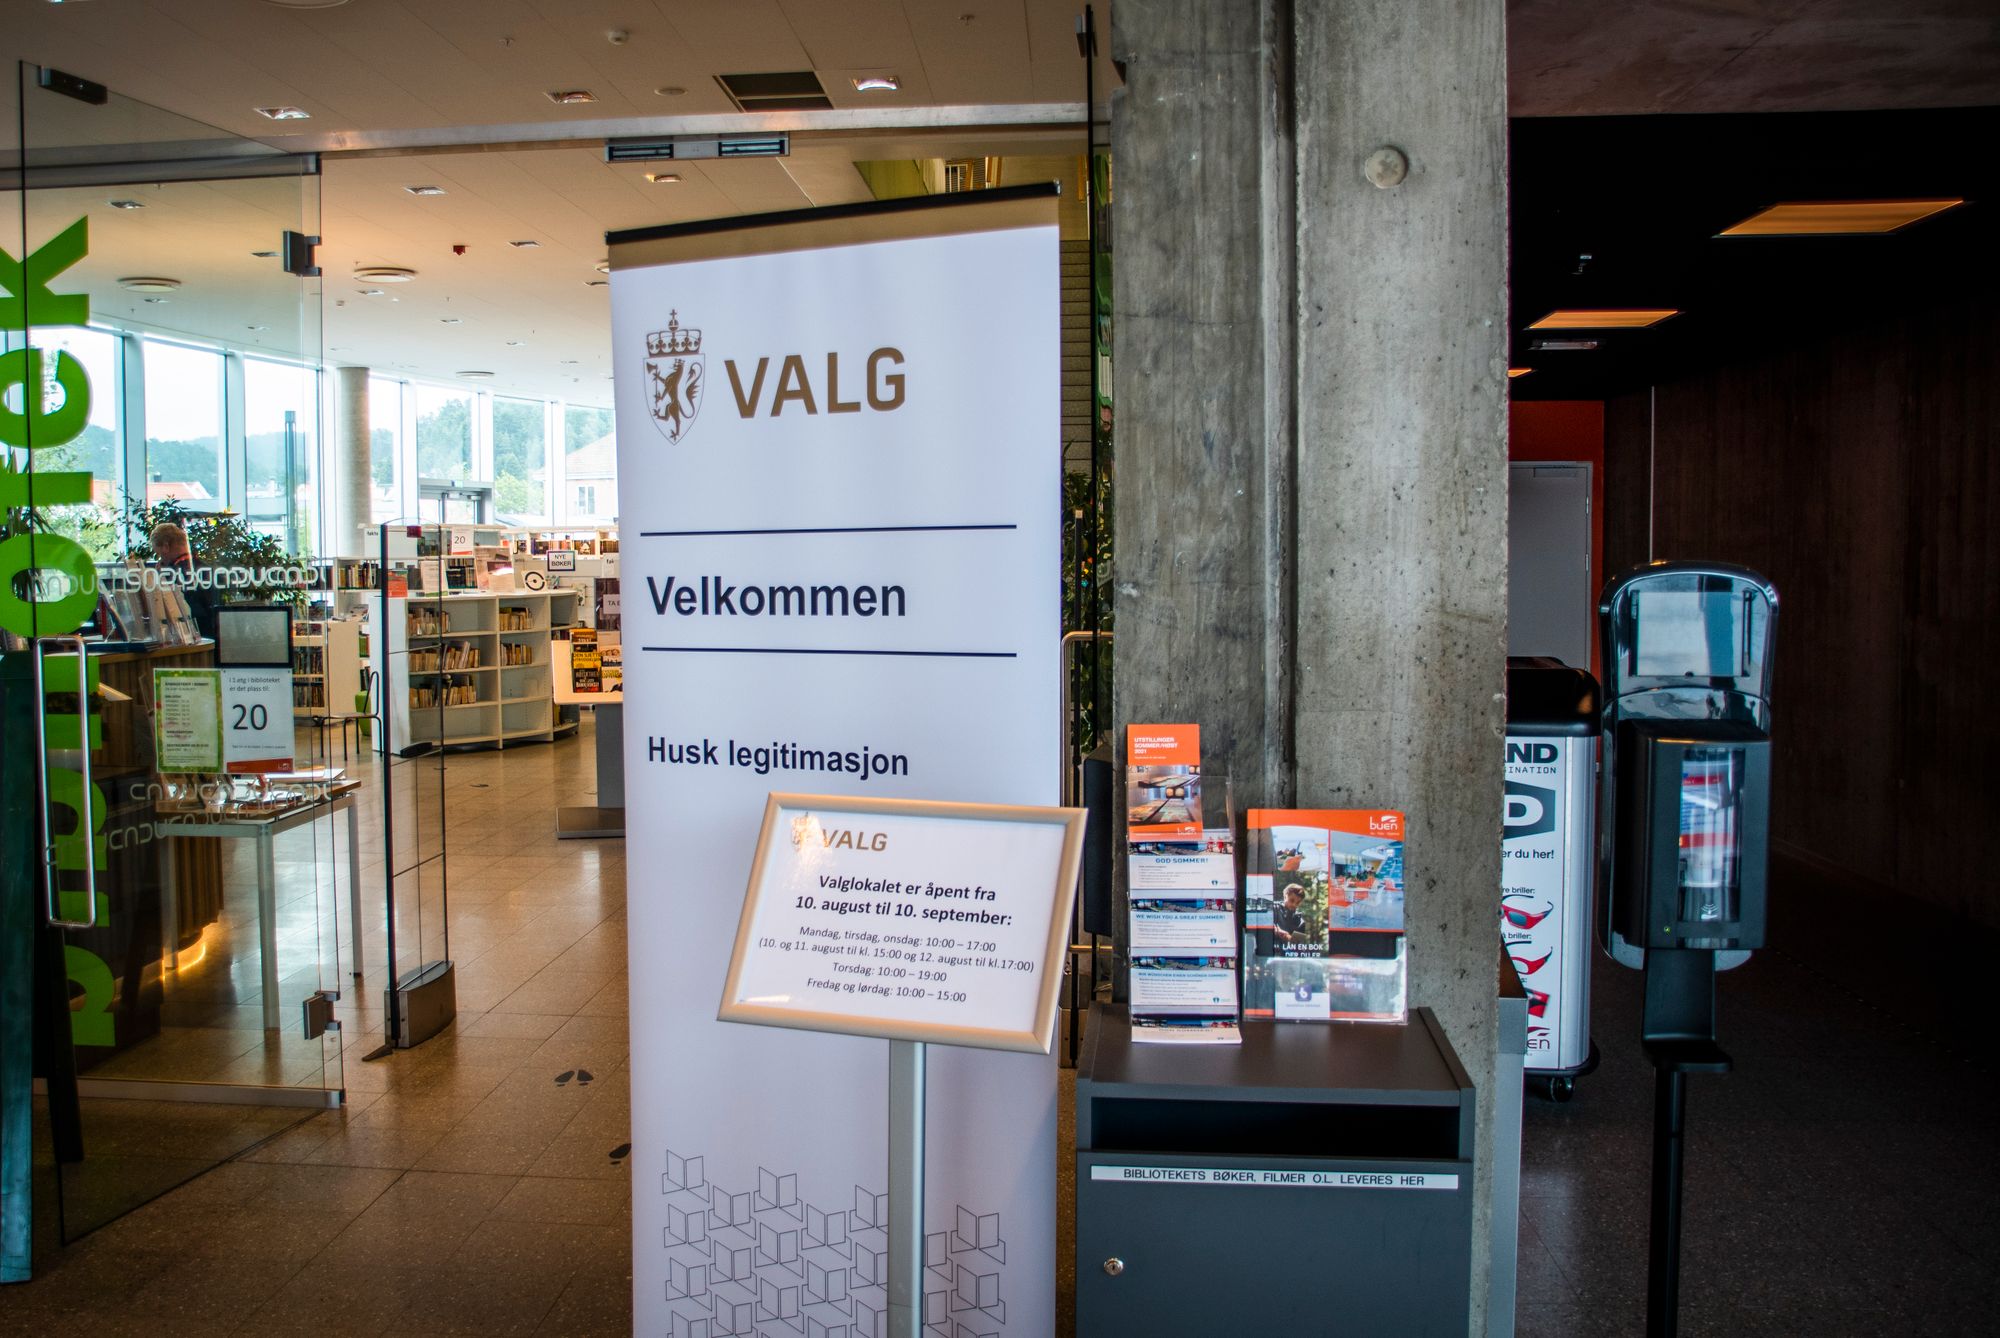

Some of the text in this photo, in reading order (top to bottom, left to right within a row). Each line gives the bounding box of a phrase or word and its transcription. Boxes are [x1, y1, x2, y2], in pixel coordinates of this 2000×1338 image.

[724, 347, 906, 419] VALG
[454, 535, 466, 544] 20
[647, 576, 906, 617] Velkommen
[232, 704, 268, 730] 20
[648, 736, 909, 781] Husk legitimasjon
[1505, 743, 1558, 764] ND
[1505, 766, 1557, 774] INATION
[823, 829, 888, 852] VALG
[1515, 849, 1529, 859] du
[1532, 849, 1554, 859] her!
[820, 875, 996, 901] Valglokalet er åpent fra
[1511, 886, 1535, 894] briller:
[795, 895, 1012, 926] 10. august til 10. september:
[799, 926, 842, 941] Mandag,
[844, 930, 881, 944] tirsdag,
[883, 934, 923, 948] onsdag:
[926, 937, 955, 949] 10:00
[966, 940, 996, 952] 17:00
[1282, 941, 1324, 951] LÅN EN BOK
[759, 937, 777, 949] (10.
[780, 941, 792, 951] og
[794, 941, 808, 951] 11.
[811, 944, 844, 955] august
[847, 945, 857, 955] til
[859, 946, 870, 957] kl.
[873, 947, 902, 960] 15:00
[904, 953, 916, 963] og
[919, 952, 935, 963] 12.
[938, 955, 972, 967] august
[975, 956, 986, 967] til
[833, 962, 875, 977] Torsdag:
[878, 966, 906, 979] 10:00
[918, 970, 947, 982] 19:00
[807, 977, 840, 992] Fredag
[843, 983, 856, 994] og
[858, 982, 894, 997] lørdag:
[896, 986, 925, 999] 10:00
[937, 990, 967, 1002] 15:00
[1123, 1168, 1206, 1181] BIBLIOTEKETS
[1263, 1172, 1306, 1183] FILMER
[1340, 1175, 1393, 1185] LEVERES
[1400, 1176, 1425, 1186] HER
